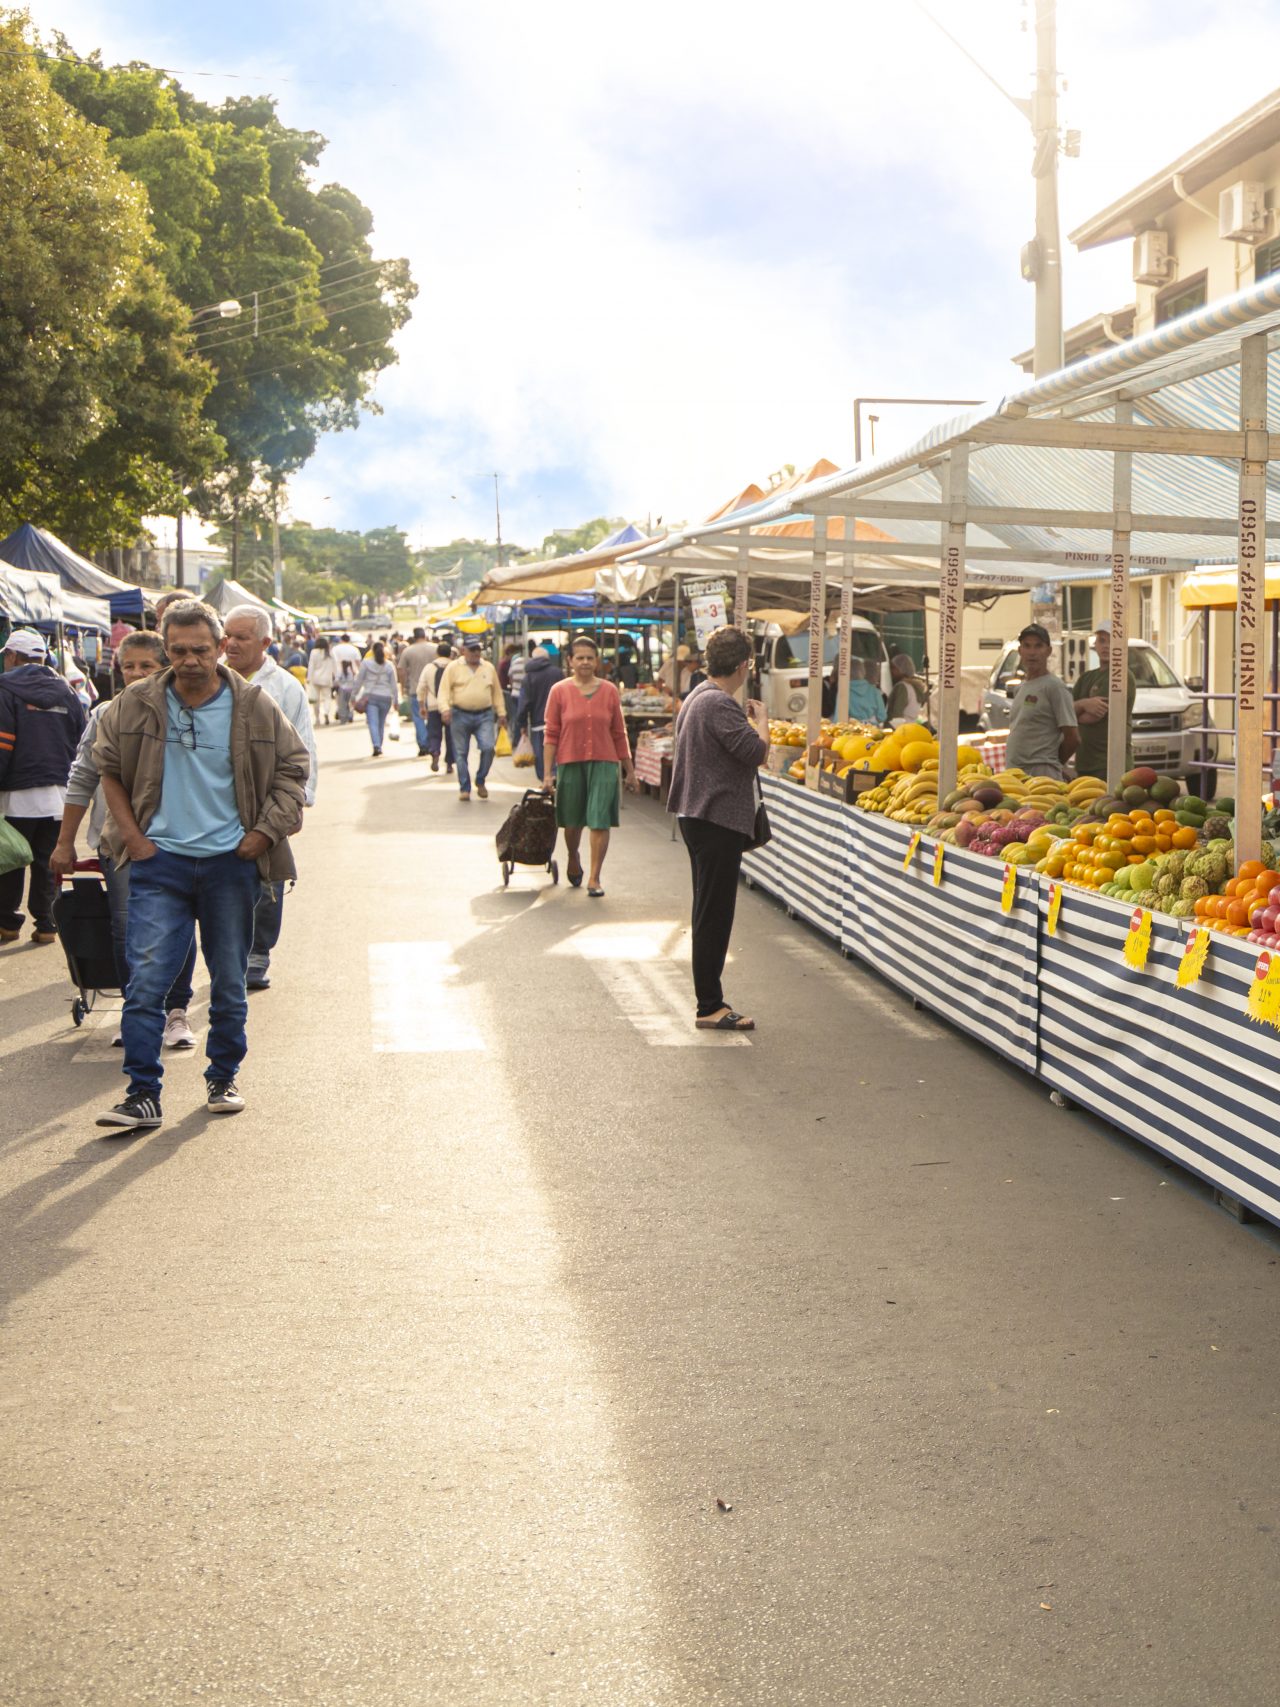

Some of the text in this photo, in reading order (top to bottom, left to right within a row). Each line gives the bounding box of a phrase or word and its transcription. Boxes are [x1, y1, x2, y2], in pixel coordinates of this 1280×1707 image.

[944, 547, 959, 688] PINHO 2747-6560
[1064, 552, 1099, 562] PINHO
[1240, 499, 1257, 711] PINHO 2747-6560
[810, 571, 822, 678] PINHO 2747-6560
[840, 647, 848, 676] PINHO
[1111, 553, 1124, 692] PINHO 2747-6560
